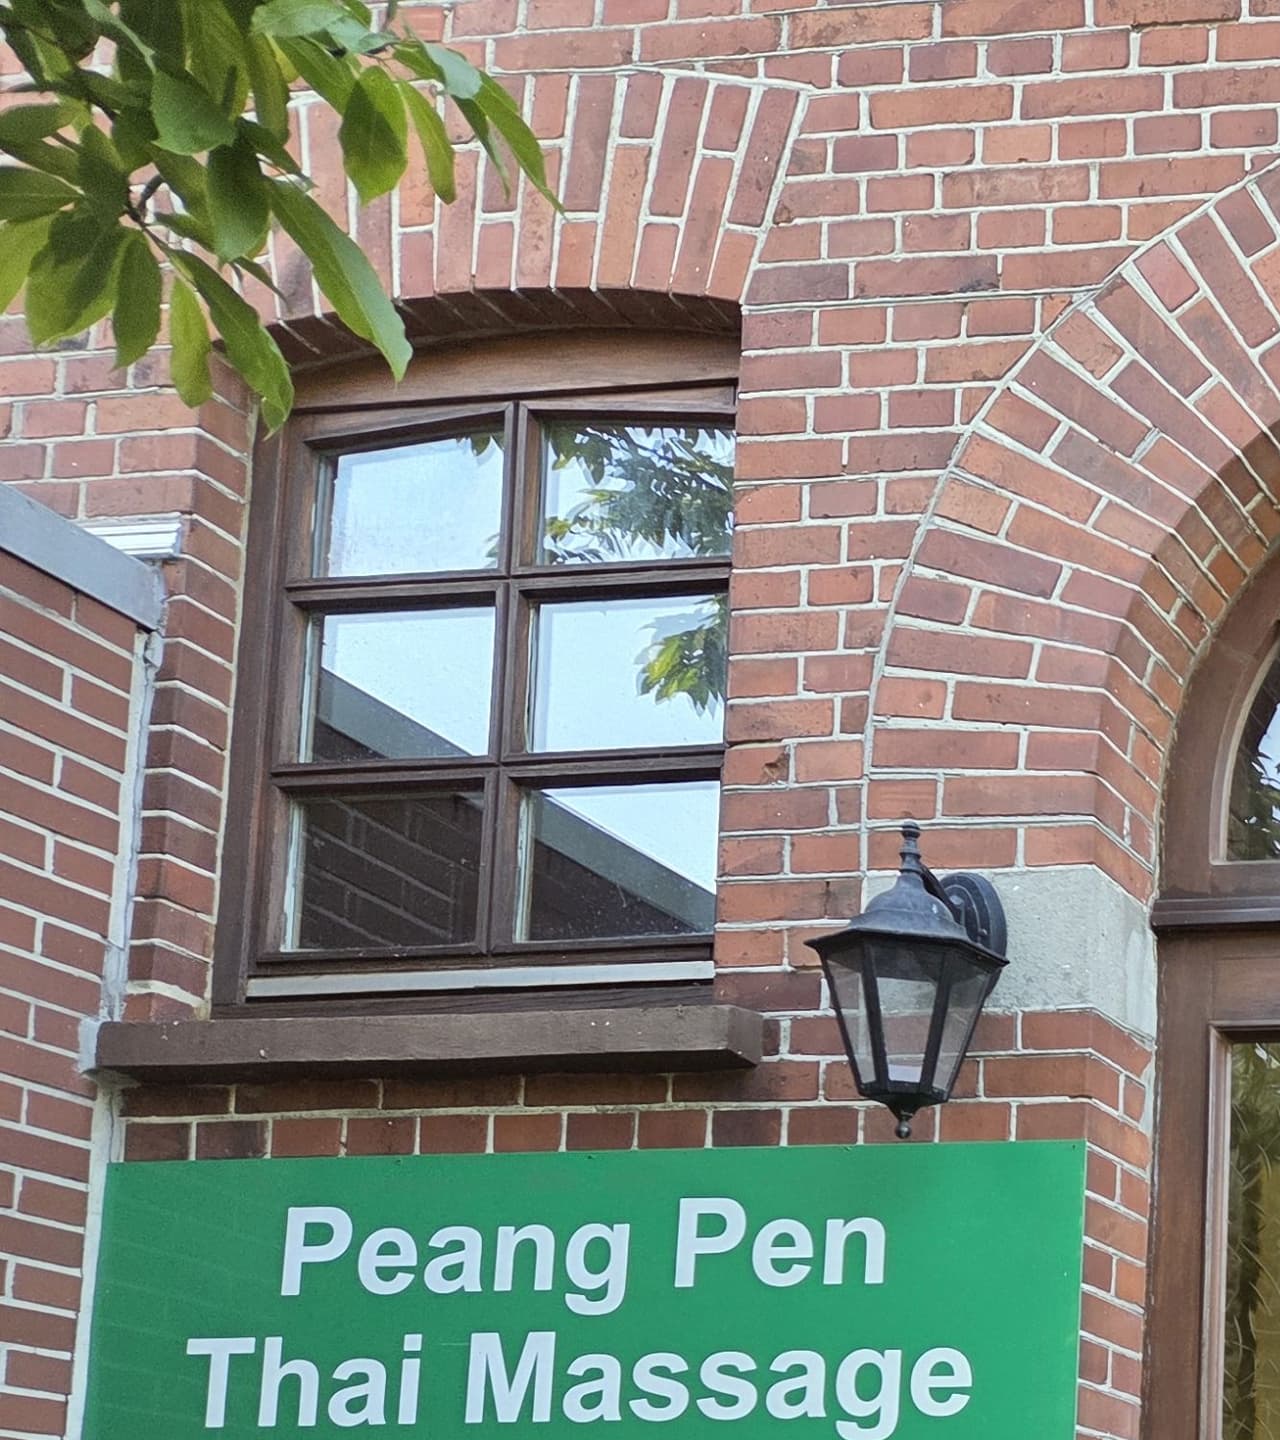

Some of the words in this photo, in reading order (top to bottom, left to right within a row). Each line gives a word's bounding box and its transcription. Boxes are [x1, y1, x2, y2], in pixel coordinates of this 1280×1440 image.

[281, 1205, 630, 1316] Peang
[673, 1197, 887, 1289] Pen
[187, 1333, 423, 1429] Thai
